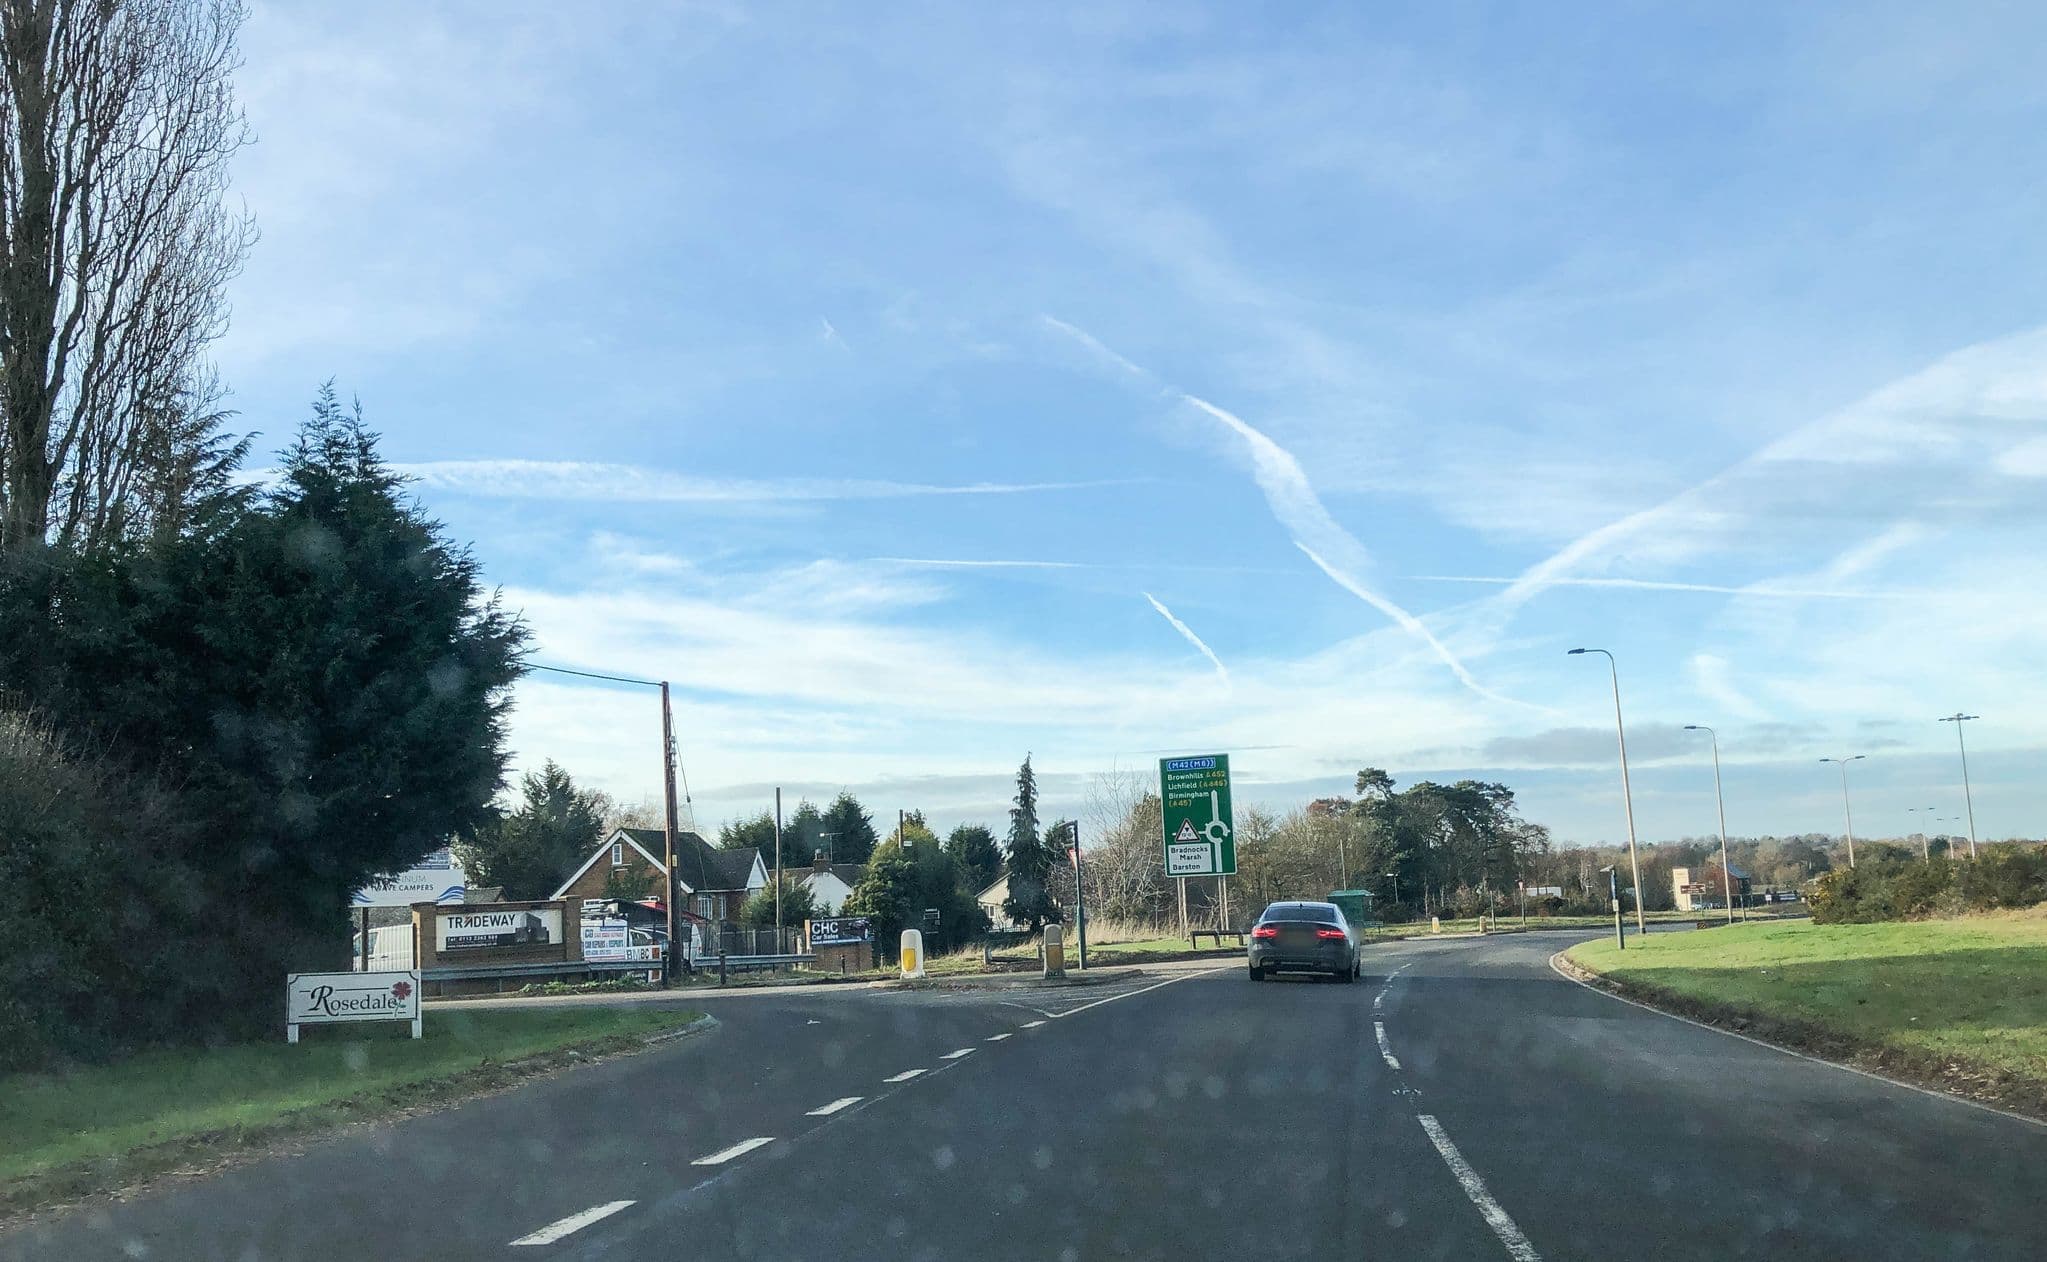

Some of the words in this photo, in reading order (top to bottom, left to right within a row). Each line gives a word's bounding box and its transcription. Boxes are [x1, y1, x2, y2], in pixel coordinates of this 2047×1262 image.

[1167, 772, 1204, 781] Brownhills
[1168, 782, 1198, 790] Lichfield
[1168, 791, 1210, 800] Birmingham
[1170, 846, 1209, 854] Bradnocks
[398, 883, 434, 892] CAMPERS
[447, 914, 516, 929] TRADEWAY
[812, 922, 838, 934] CHC
[308, 985, 397, 1016] Rosedale
